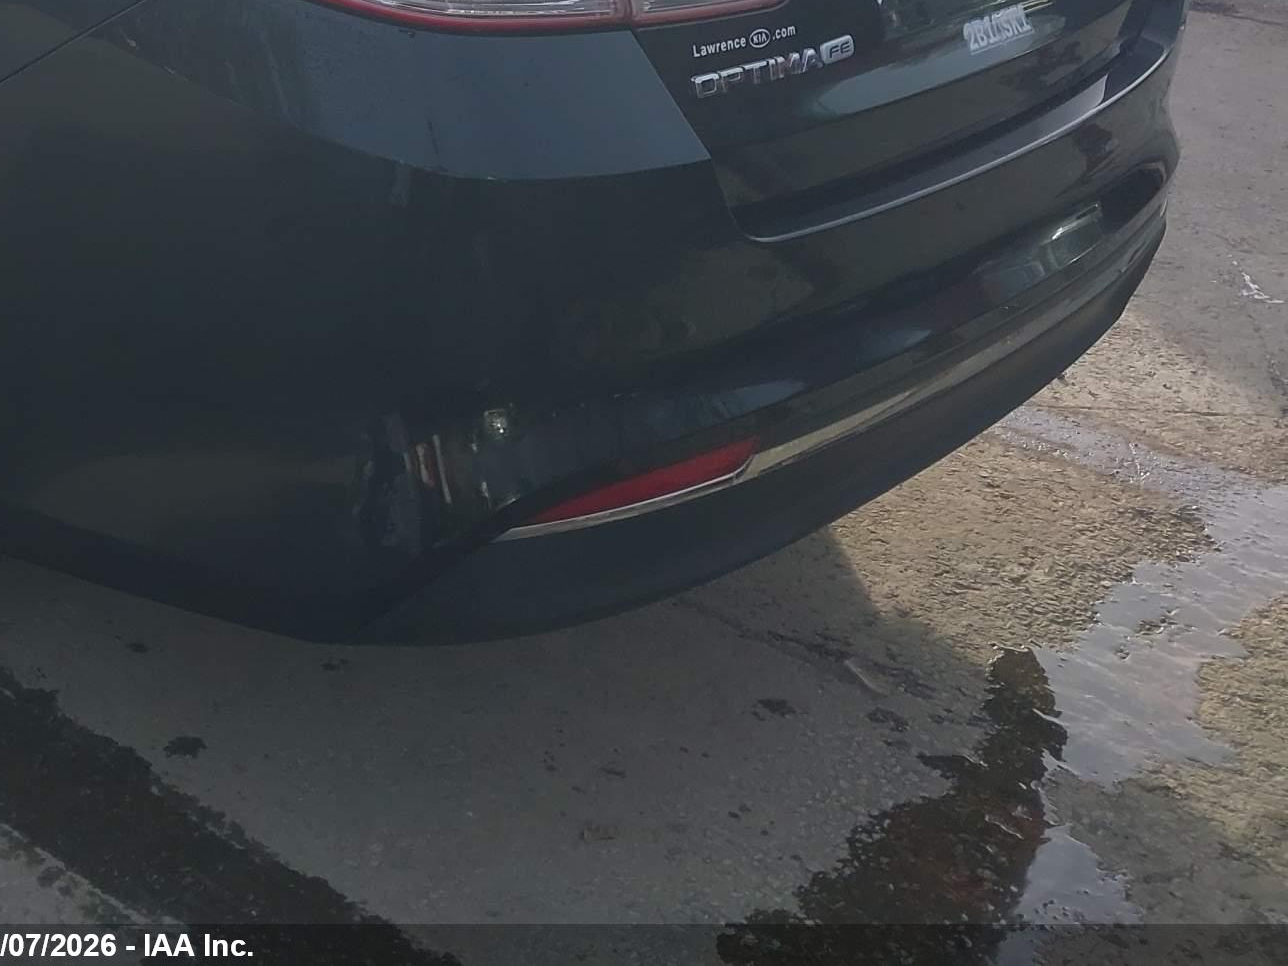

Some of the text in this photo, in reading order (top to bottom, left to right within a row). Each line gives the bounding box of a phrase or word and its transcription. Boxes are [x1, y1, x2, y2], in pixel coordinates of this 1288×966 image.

[692, 36, 747, 58] Lawrence
[690, 40, 852, 99] OPTIMA FE
